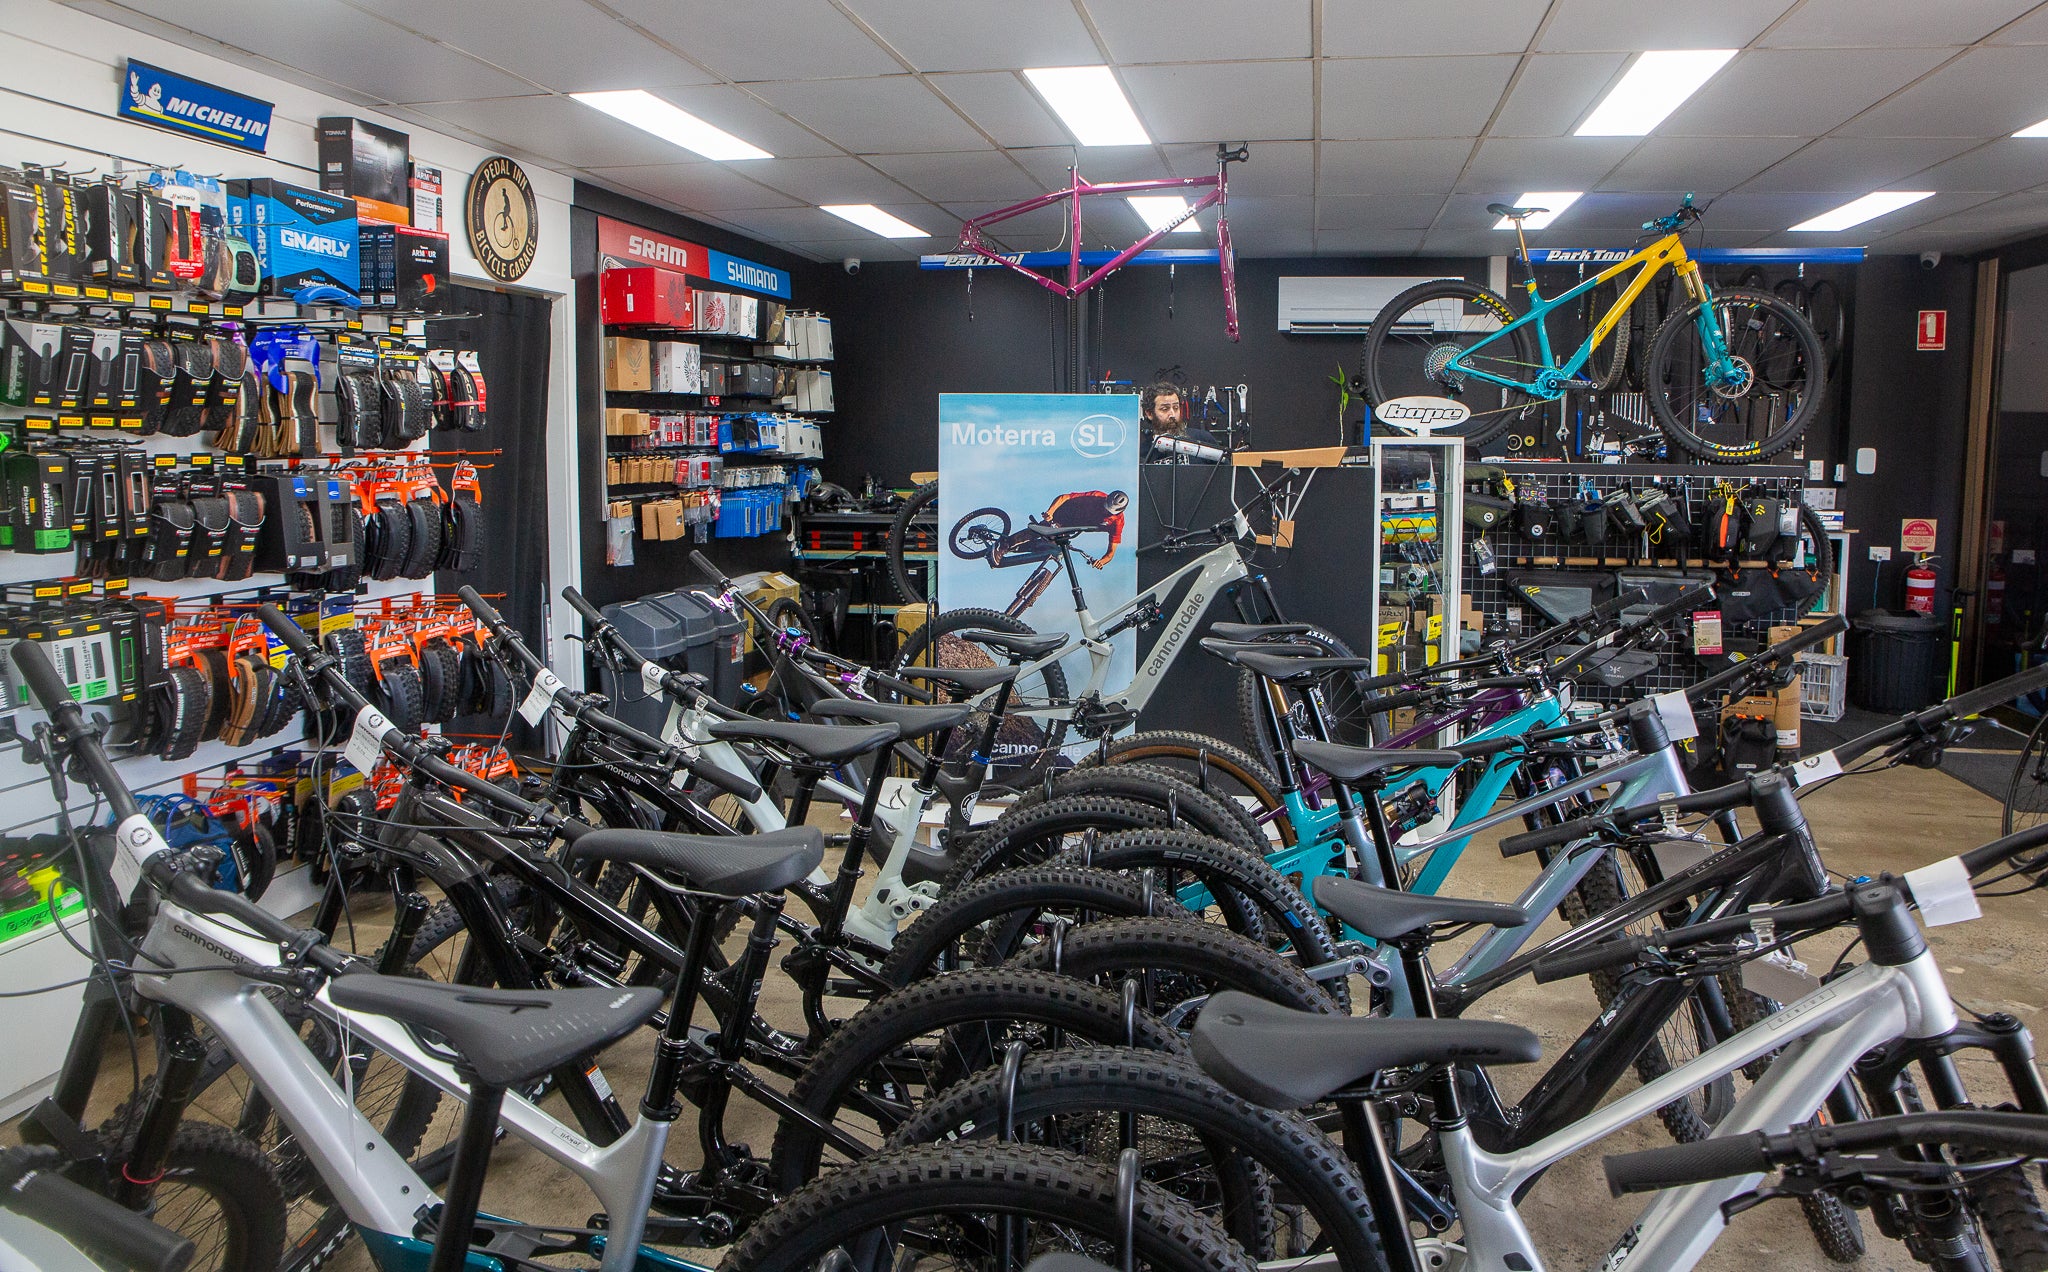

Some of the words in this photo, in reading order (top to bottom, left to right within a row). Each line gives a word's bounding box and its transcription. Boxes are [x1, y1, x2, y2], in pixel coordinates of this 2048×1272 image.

[166, 97, 267, 137] MICHELIN
[483, 159, 510, 184] PEDAL
[512, 165, 528, 191] INN
[286, 189, 317, 202] ENHANCED
[318, 197, 343, 208] TUBELESS
[296, 199, 336, 214] Performance
[34, 184, 49, 276] GOODYEAR
[62, 189, 76, 256] GOODYEAR
[256, 204, 267, 269] GNARLY
[280, 228, 351, 258] GNARLY
[475, 229, 506, 278] BICYCLE
[509, 236, 536, 278] GARAGE
[629, 235, 688, 268] SRAM
[1545, 249, 1591, 262] Park
[1592, 249, 1635, 262] Tool
[944, 253, 988, 267] Park
[727, 260, 778, 292] SHIMANO
[1478, 293, 1514, 321] MAXXIS
[1384, 403, 1464, 424] hope
[951, 422, 1056, 447] Moterra
[1076, 423, 1115, 448] SL
[1717, 448, 1761, 456] MAXXIS
[42, 482, 52, 528] Cinturato
[1146, 592, 1206, 679] cannondale
[1305, 630, 1334, 645] AXXIS
[991, 743, 1081, 757] cannoale
[592, 756, 642, 787] cannondale
[1163, 850, 1289, 912] SCHWALBE
[173, 924, 250, 966] cannondal
